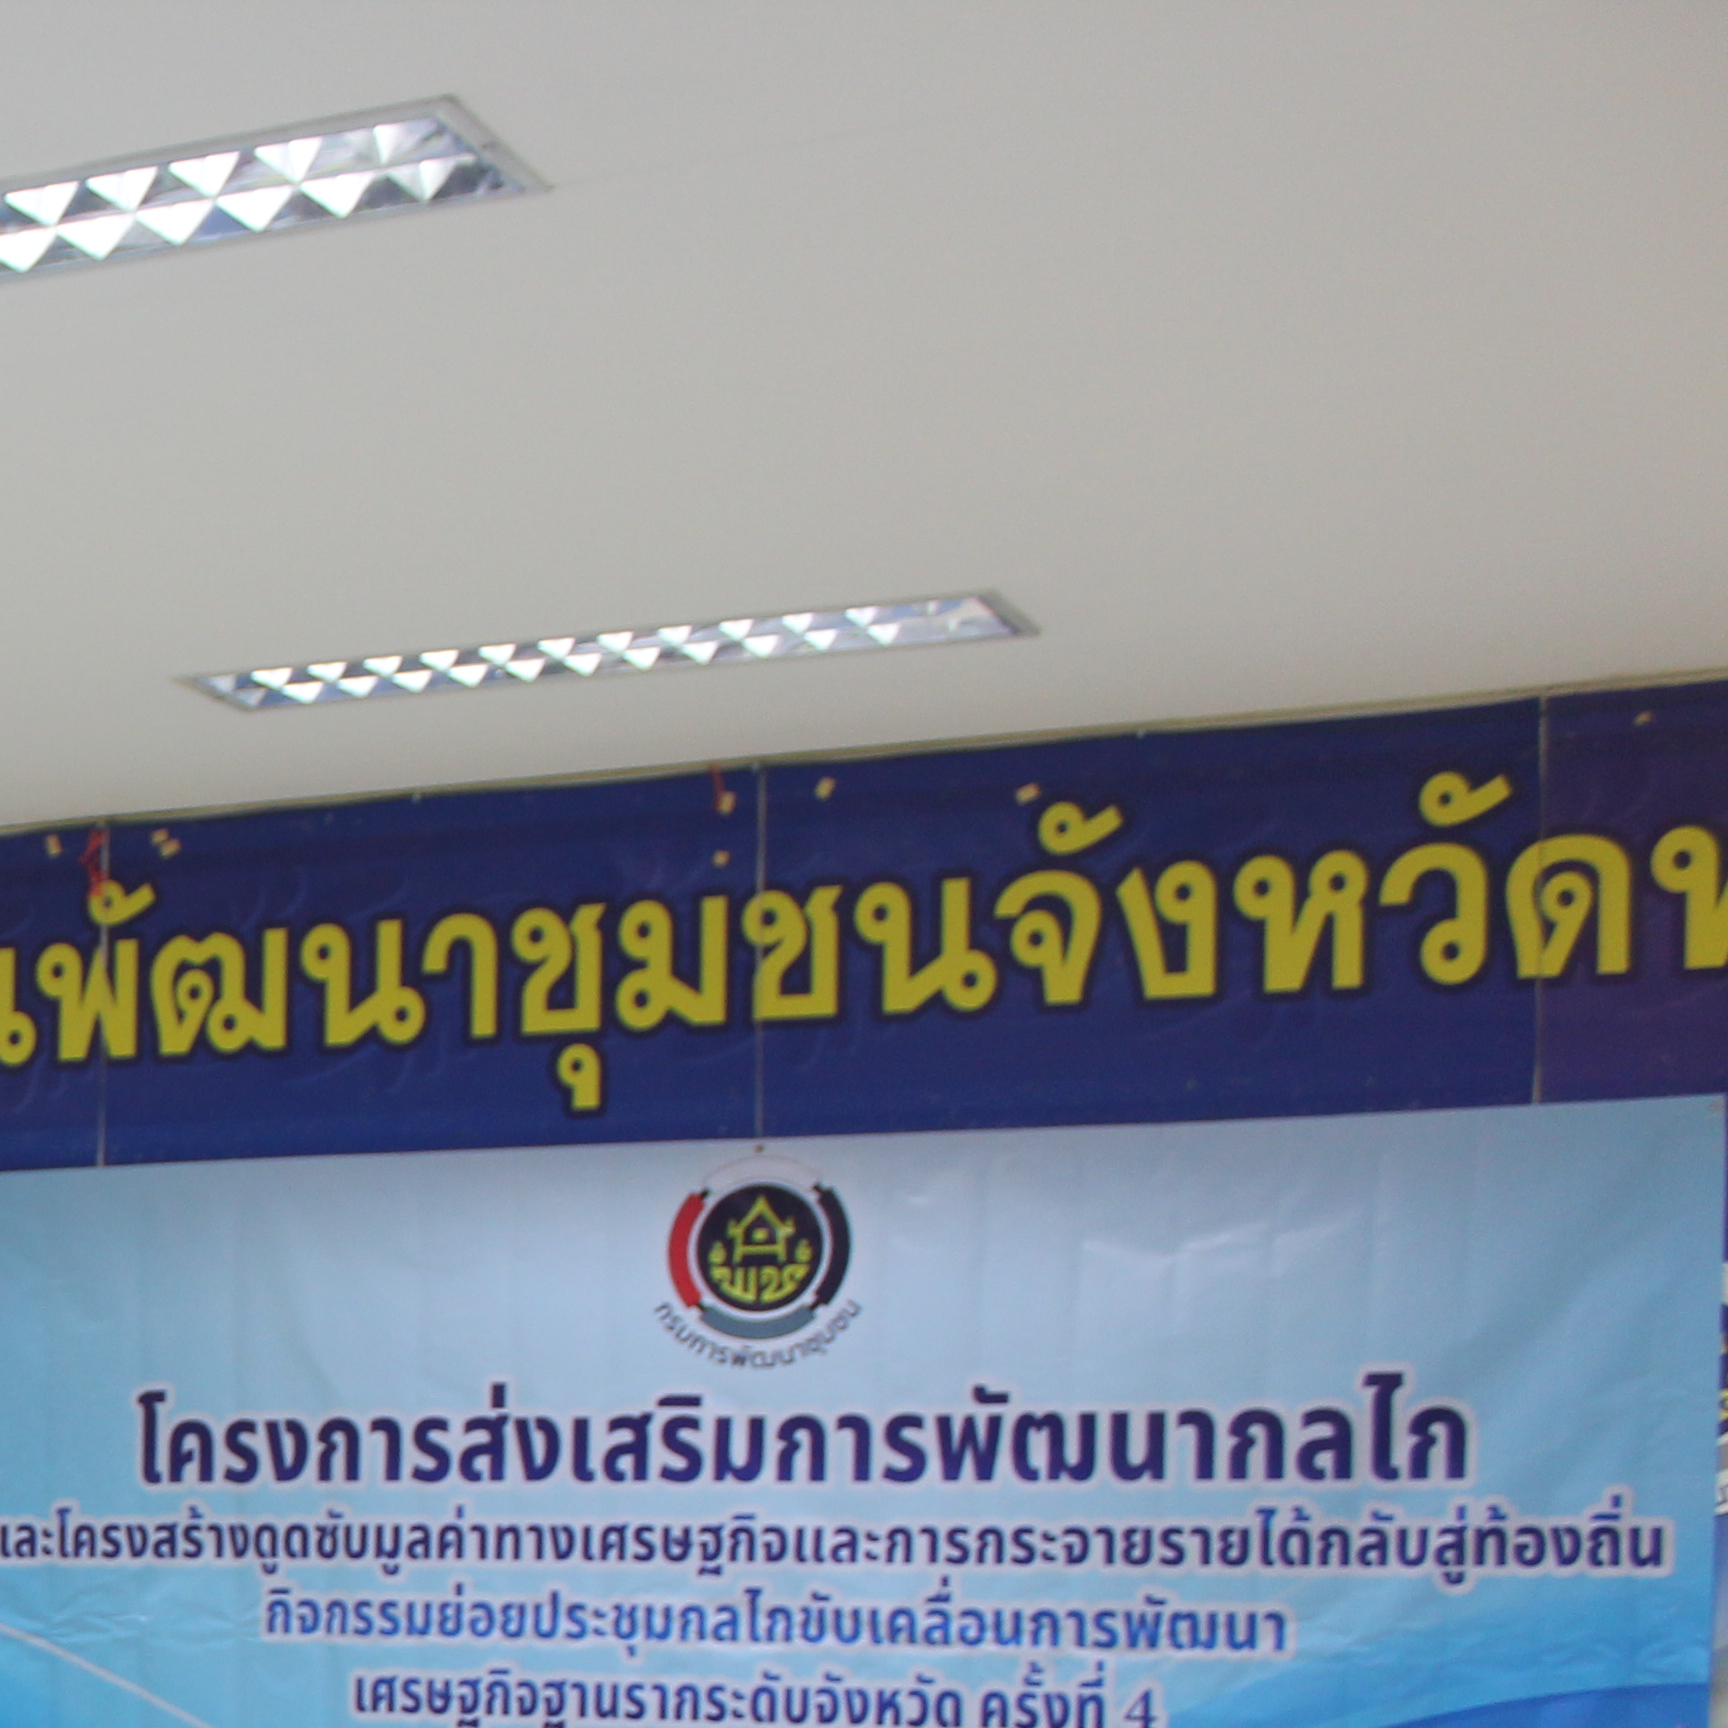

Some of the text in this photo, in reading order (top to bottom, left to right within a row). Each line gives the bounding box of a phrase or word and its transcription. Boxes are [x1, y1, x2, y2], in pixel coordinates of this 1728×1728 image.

[137, 1372, 1468, 1485] โครงการส่งเสริมการพัฒนากลไก
[265, 1577, 1287, 1659] กิจกรรมย่อยประชุมกลไกขับเคลื่อนการพัฒนา
